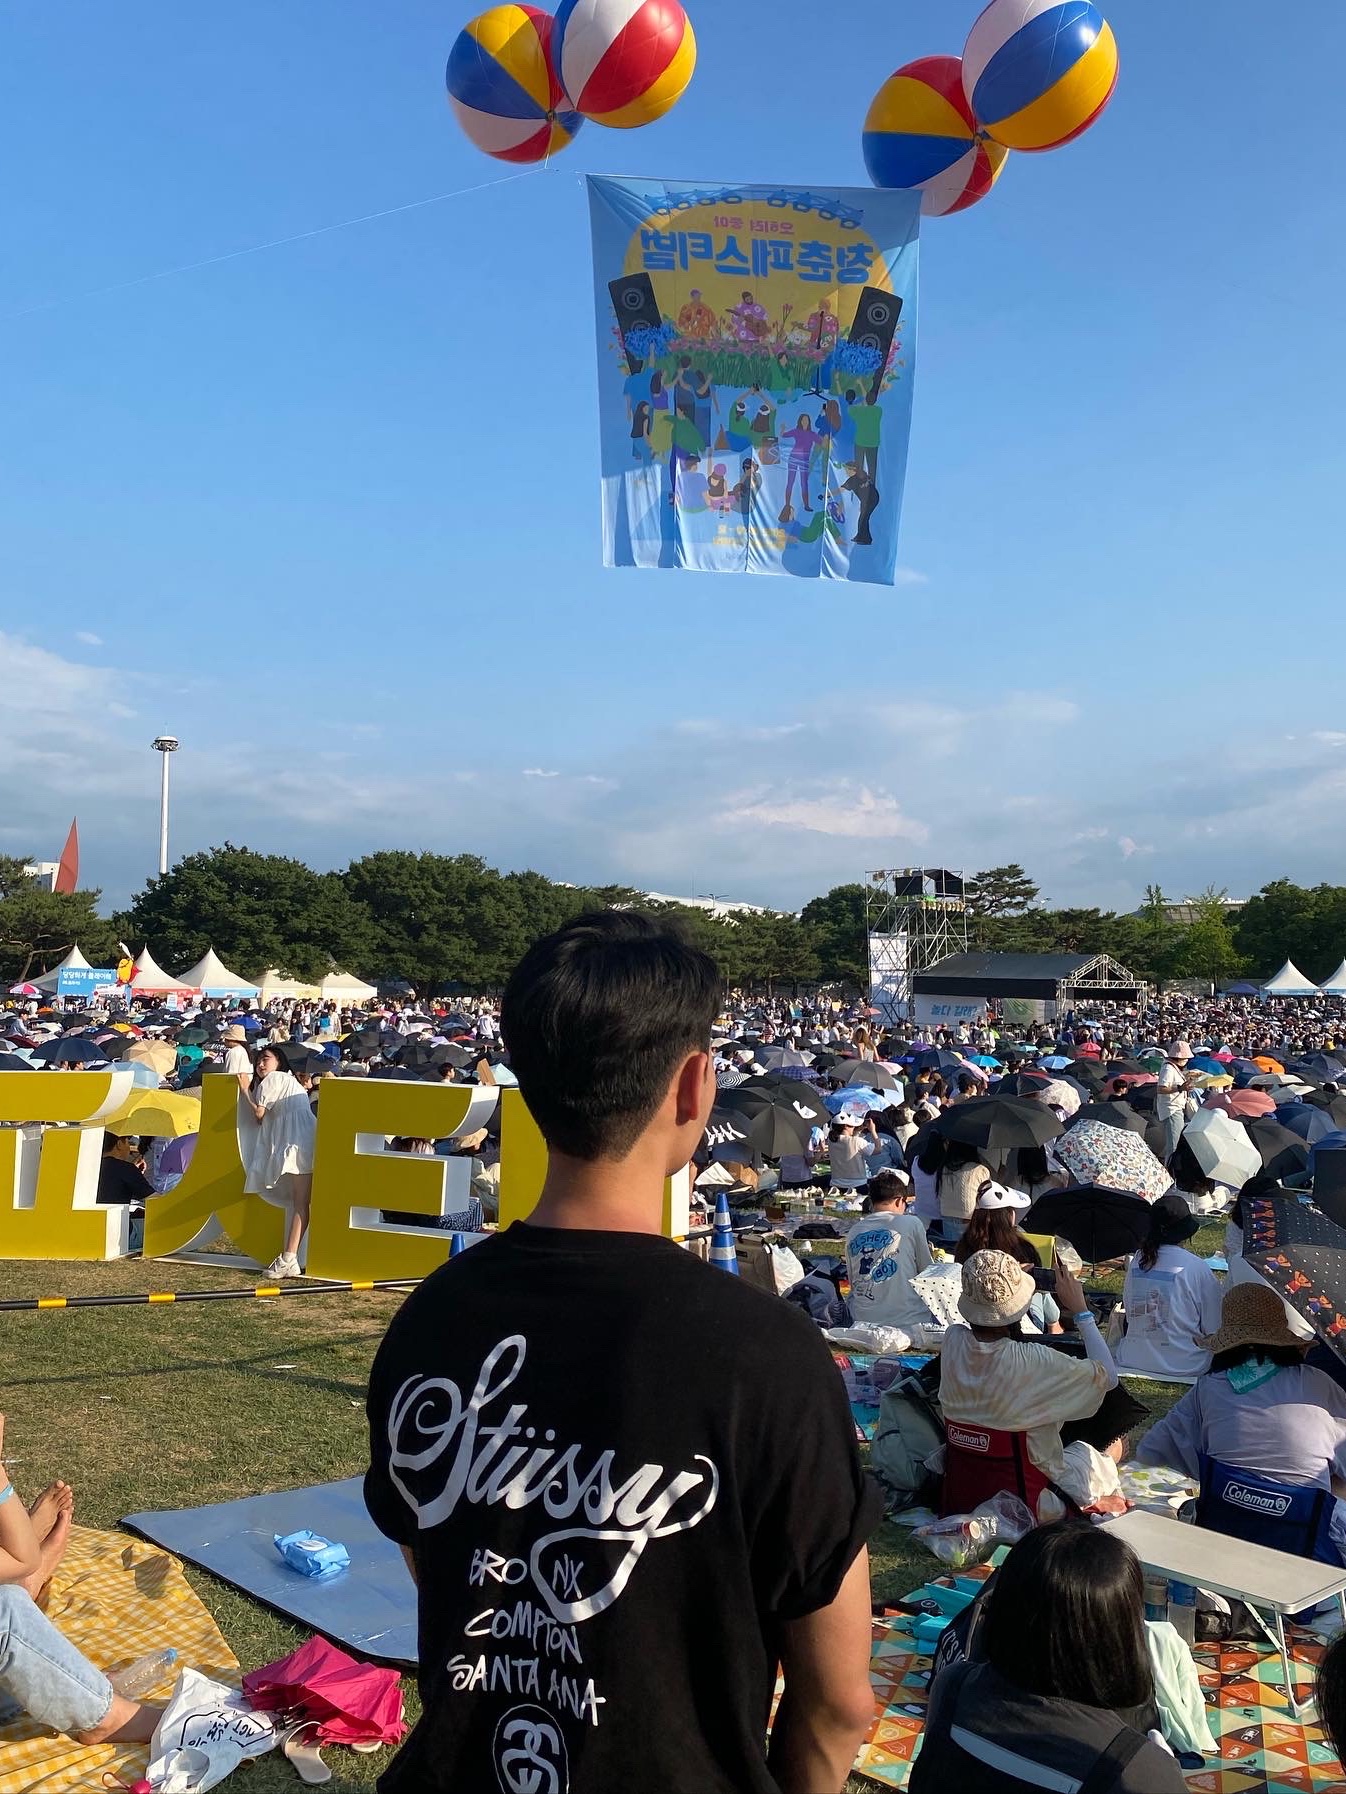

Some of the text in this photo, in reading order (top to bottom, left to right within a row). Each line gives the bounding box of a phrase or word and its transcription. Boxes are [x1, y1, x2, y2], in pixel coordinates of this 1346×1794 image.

[875, 1261, 897, 1279] BOY
[950, 1427, 979, 1445] Coleman
[1228, 1485, 1275, 1509] Coleman
[464, 1601, 583, 1664] COMPTON
[446, 1654, 606, 1726] SANTA ANA
